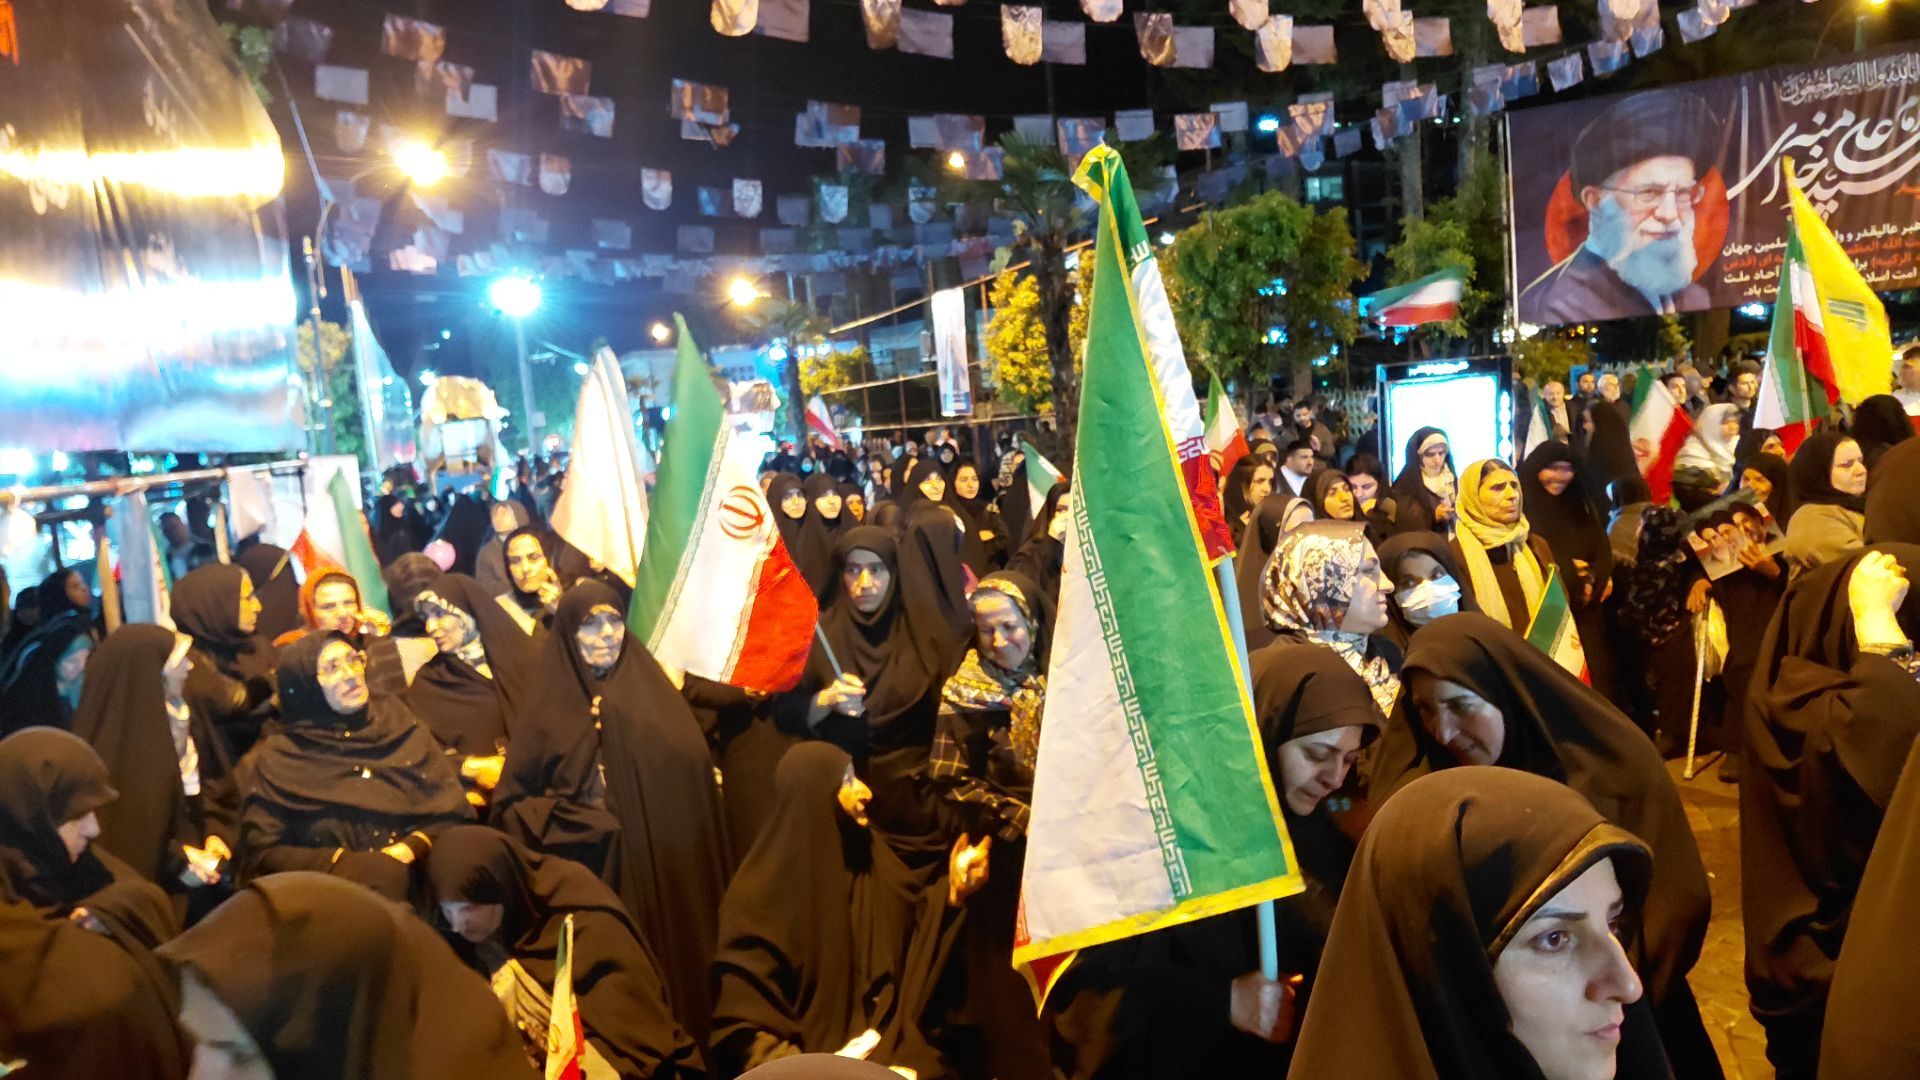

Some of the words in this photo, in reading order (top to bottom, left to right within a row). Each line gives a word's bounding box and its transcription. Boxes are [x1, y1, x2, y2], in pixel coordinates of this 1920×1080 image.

[1722, 242, 1753, 257] جهان
[1754, 236, 1788, 254] سلمین
[1723, 270, 1751, 284] ملت
